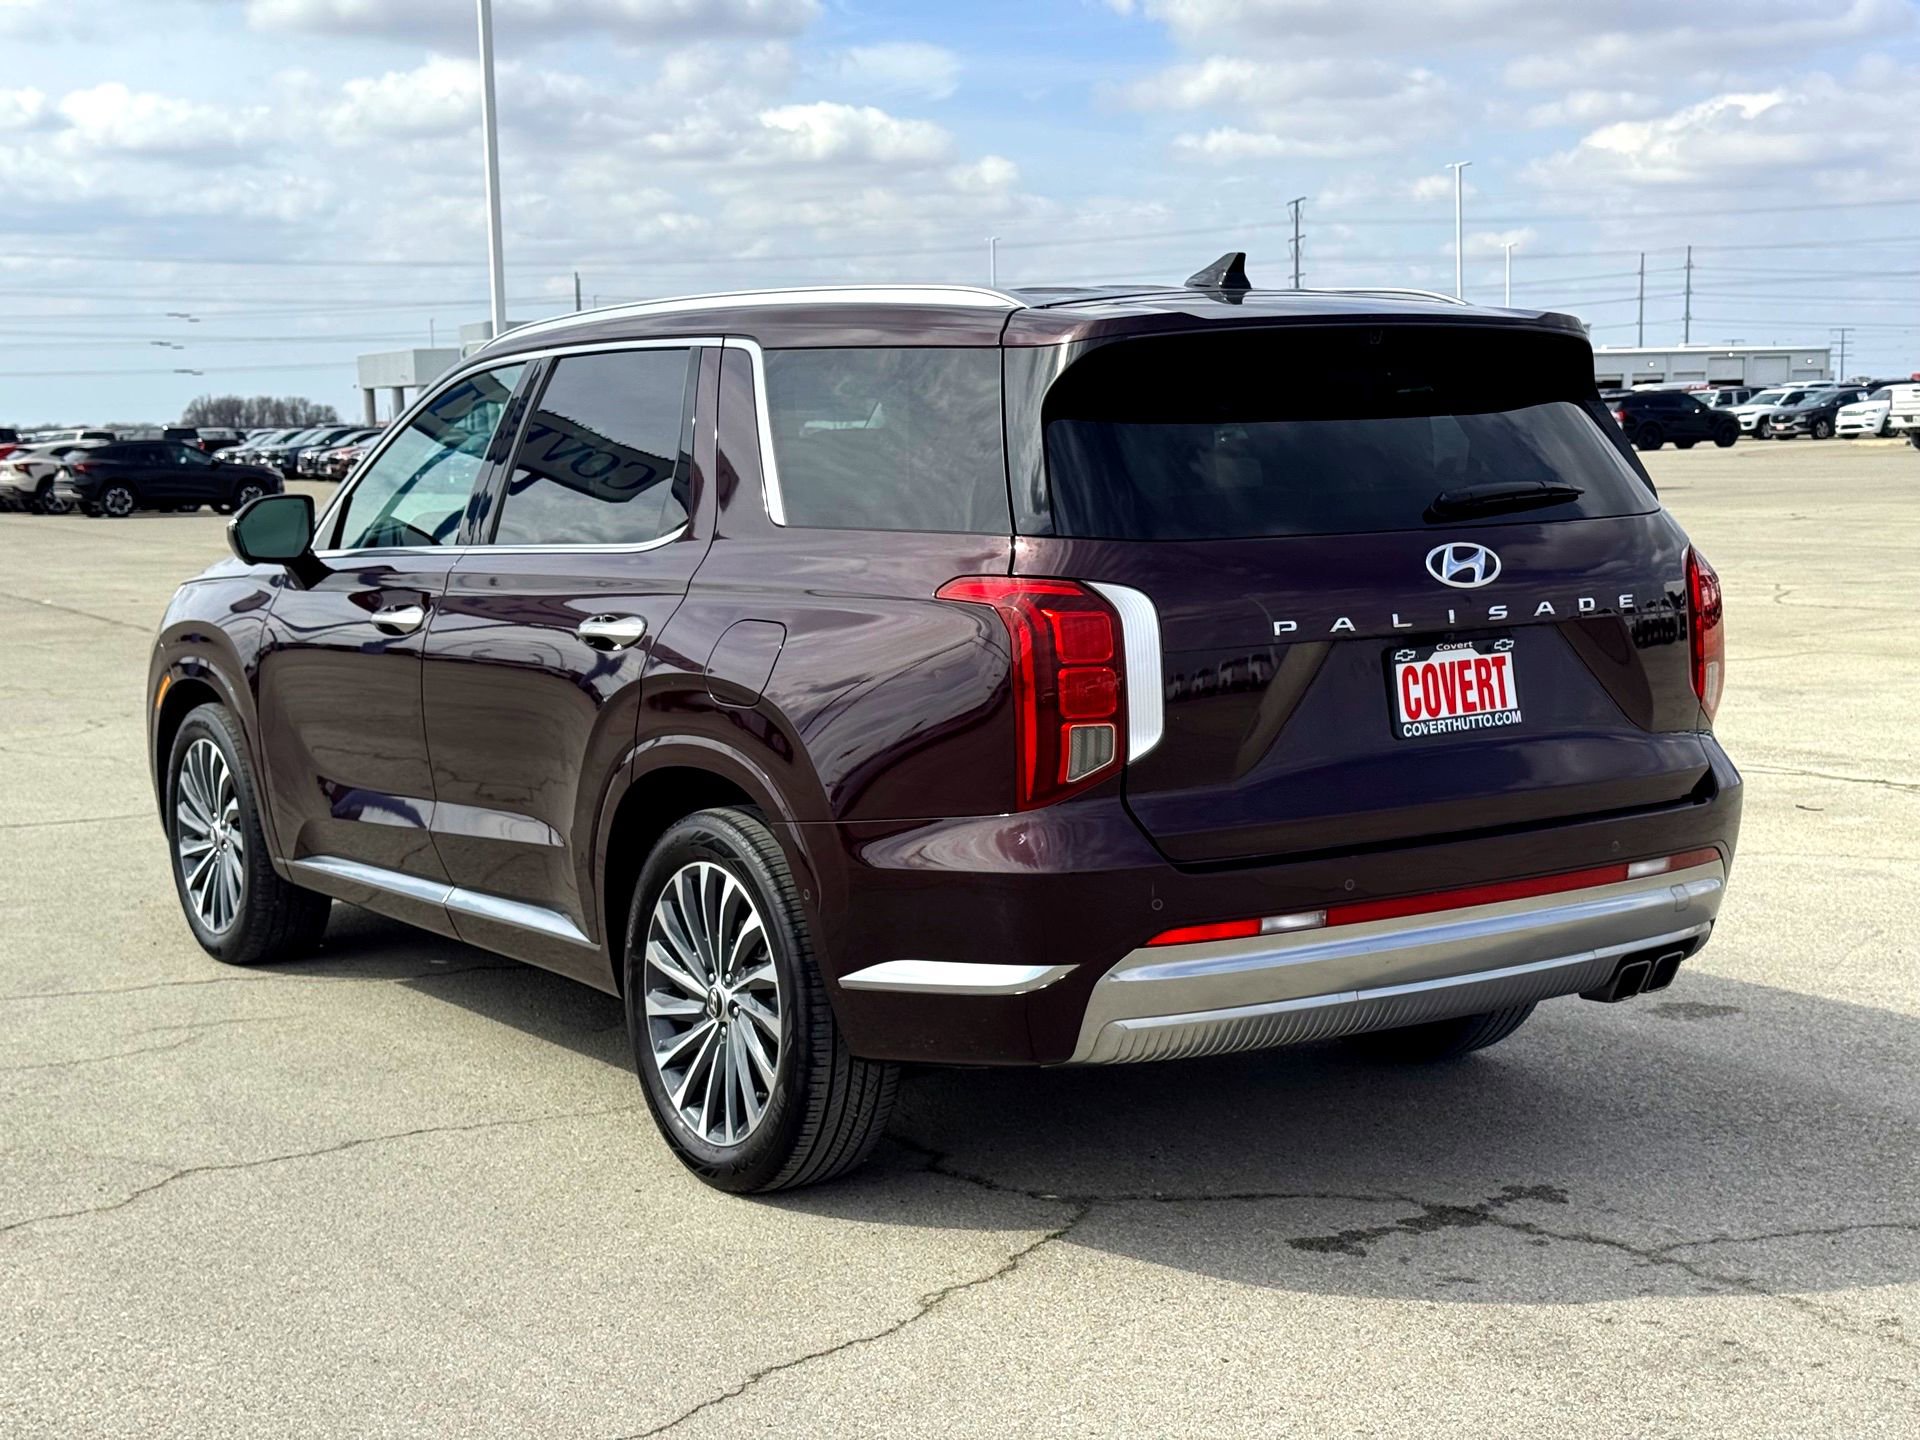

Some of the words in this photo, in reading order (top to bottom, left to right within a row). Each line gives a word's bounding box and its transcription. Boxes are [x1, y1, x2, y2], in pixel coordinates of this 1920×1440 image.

[1272, 593, 1634, 636] PALISADE
[1435, 641, 1473, 651] Covert
[1401, 654, 1508, 721] COVERT
[1402, 709, 1522, 738] COVERTHUTTO.COM
